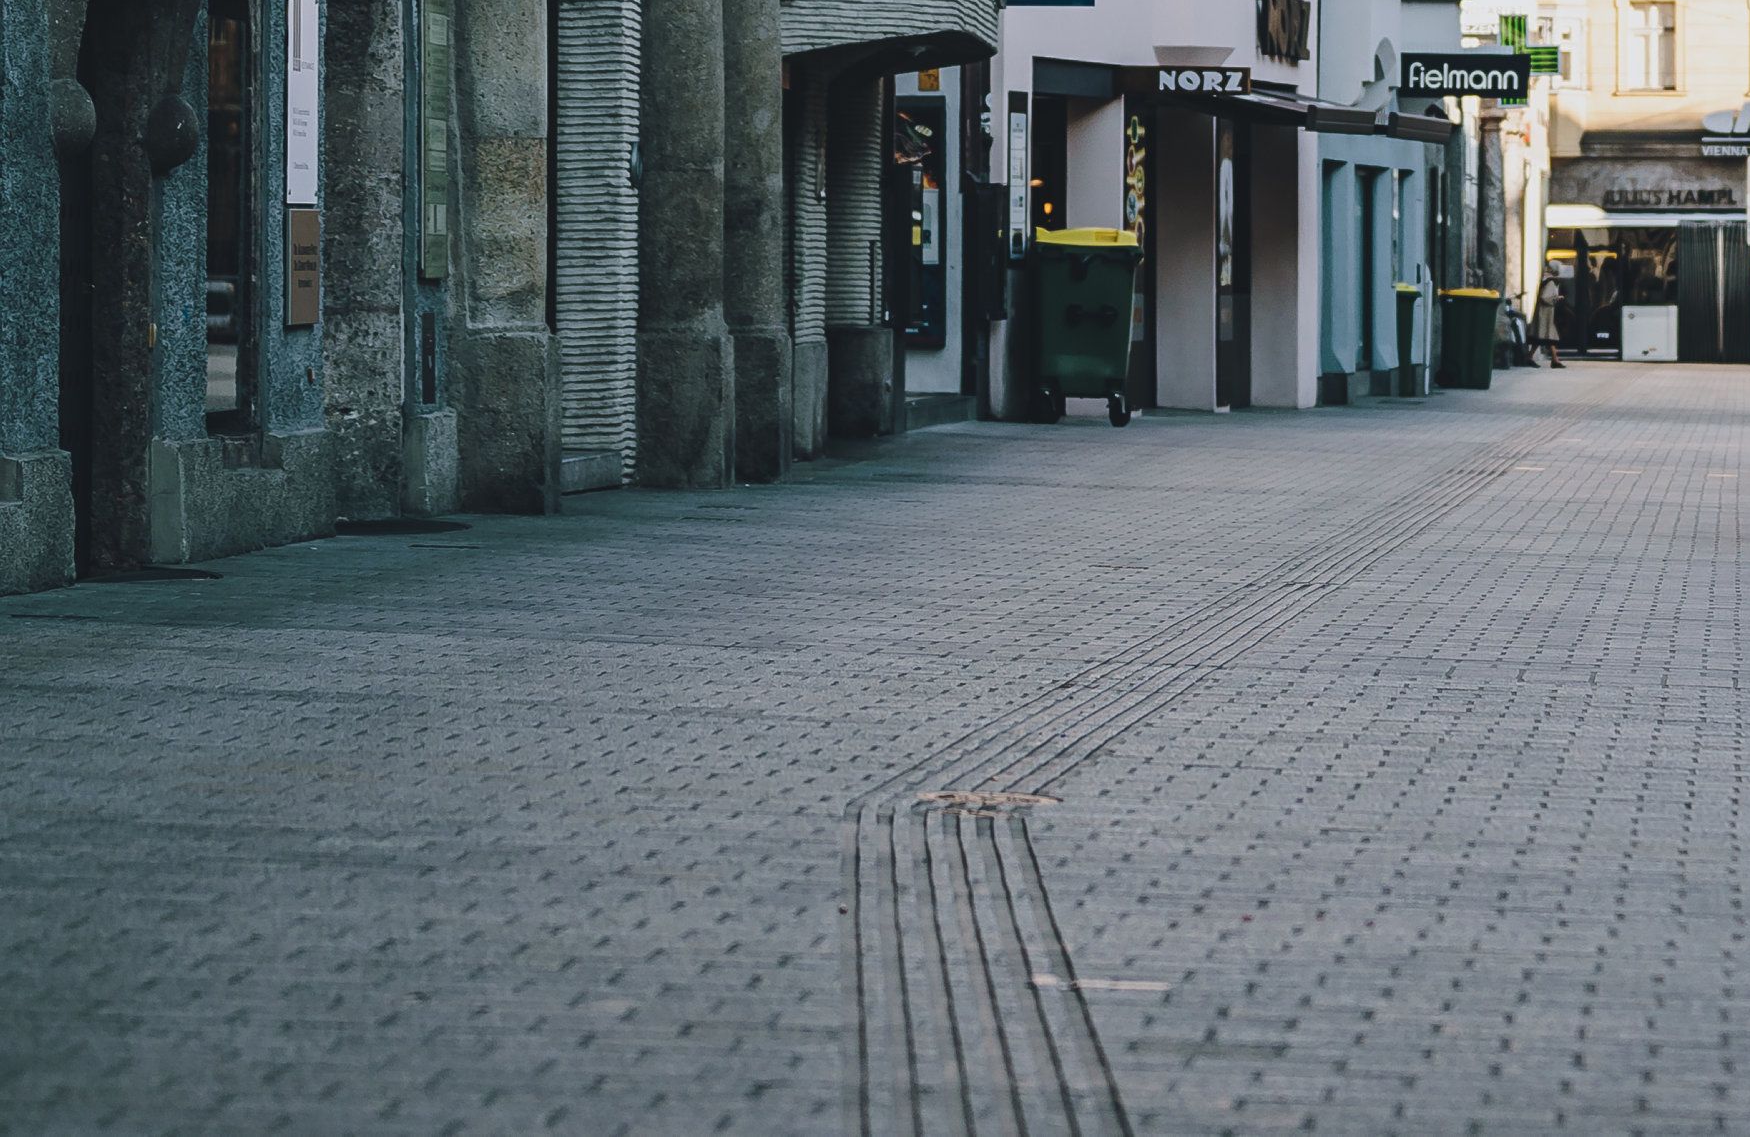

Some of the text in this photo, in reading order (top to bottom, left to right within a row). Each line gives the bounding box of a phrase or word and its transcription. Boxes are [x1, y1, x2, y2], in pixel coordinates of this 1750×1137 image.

[1158, 70, 1243, 92] NORZ
[1408, 61, 1519, 90] fielmann
[1701, 145, 1748, 157] VIENNA
